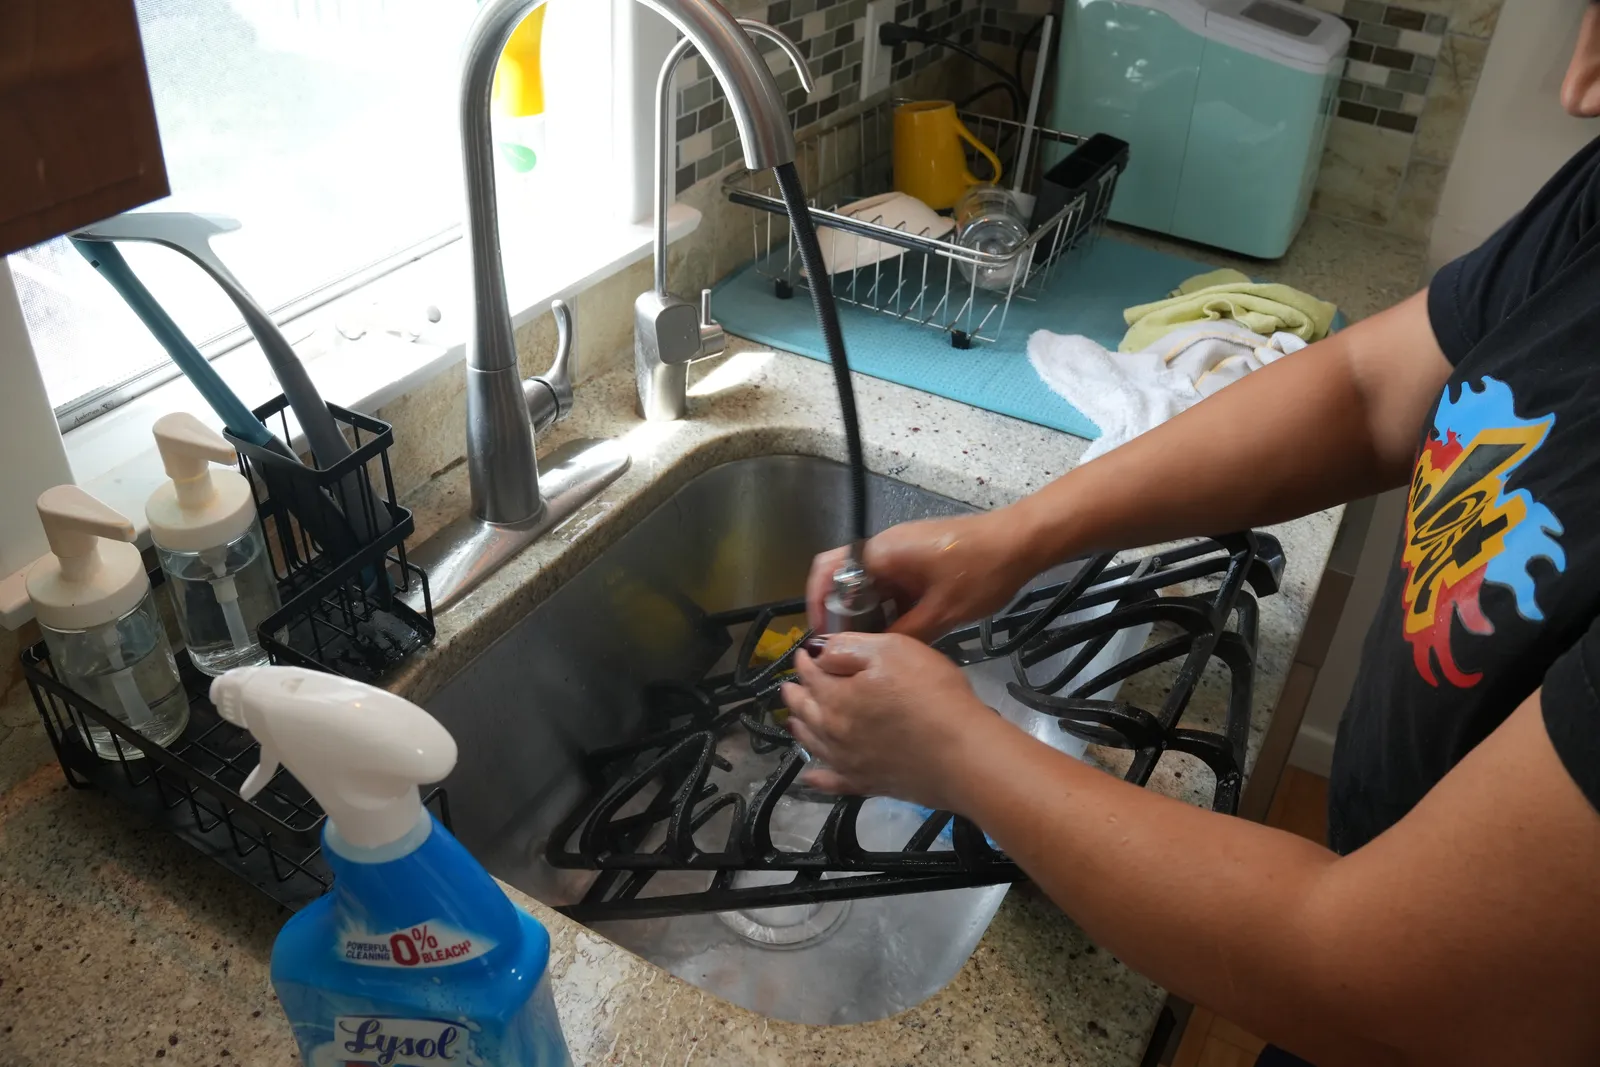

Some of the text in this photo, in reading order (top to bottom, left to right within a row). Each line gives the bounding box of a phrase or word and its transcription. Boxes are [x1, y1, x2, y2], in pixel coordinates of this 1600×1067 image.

[346, 940, 390, 952] POWERFUL
[346, 950, 390, 961] CLEANING
[390, 925, 438, 966] 0%
[339, 1019, 457, 1065] Lysol
